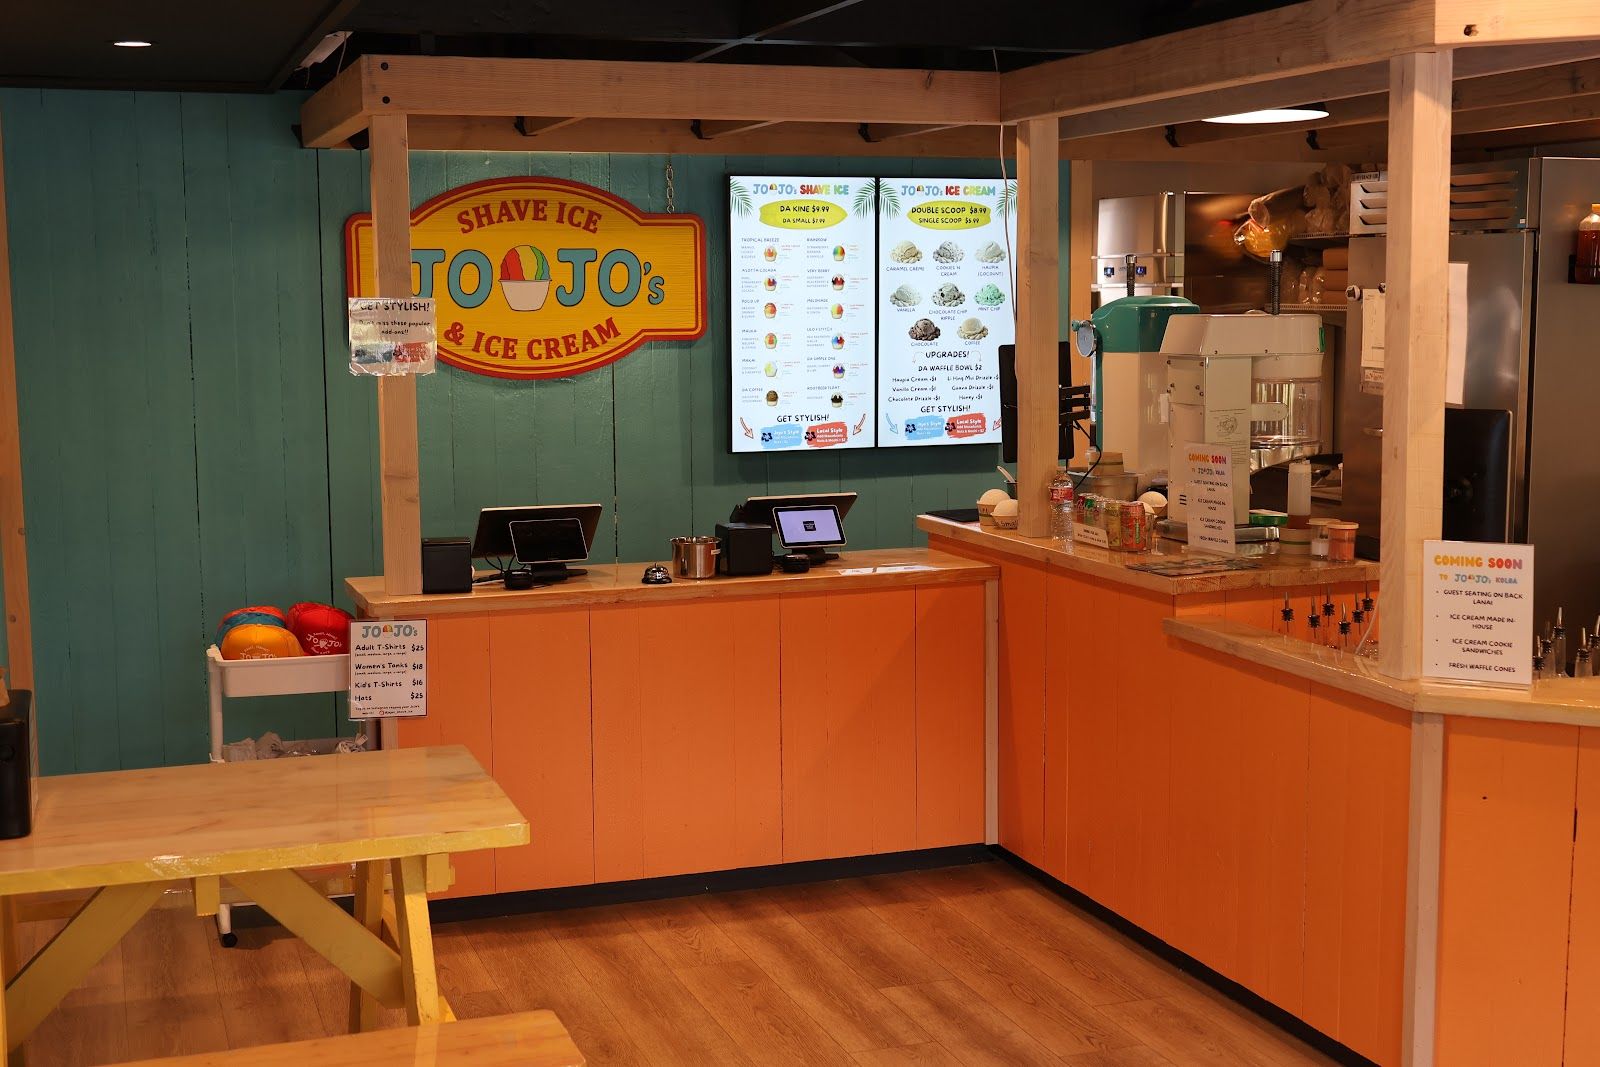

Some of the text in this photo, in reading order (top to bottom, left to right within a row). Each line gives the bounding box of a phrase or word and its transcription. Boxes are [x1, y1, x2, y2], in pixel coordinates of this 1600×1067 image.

[800, 184, 830, 195] SHAVE
[834, 185, 849, 194] ICE
[945, 186, 960, 195] ICE
[963, 186, 995, 196] CREAM
[457, 199, 603, 234] SHAVE ICE
[384, 302, 430, 312] STYLISH!
[443, 317, 622, 360] & ICE CREAM
[1189, 453, 1210, 462] COMING
[1211, 455, 1227, 464] SOON
[1434, 555, 1523, 569] COMING SOON
[412, 644, 424, 652] $25
